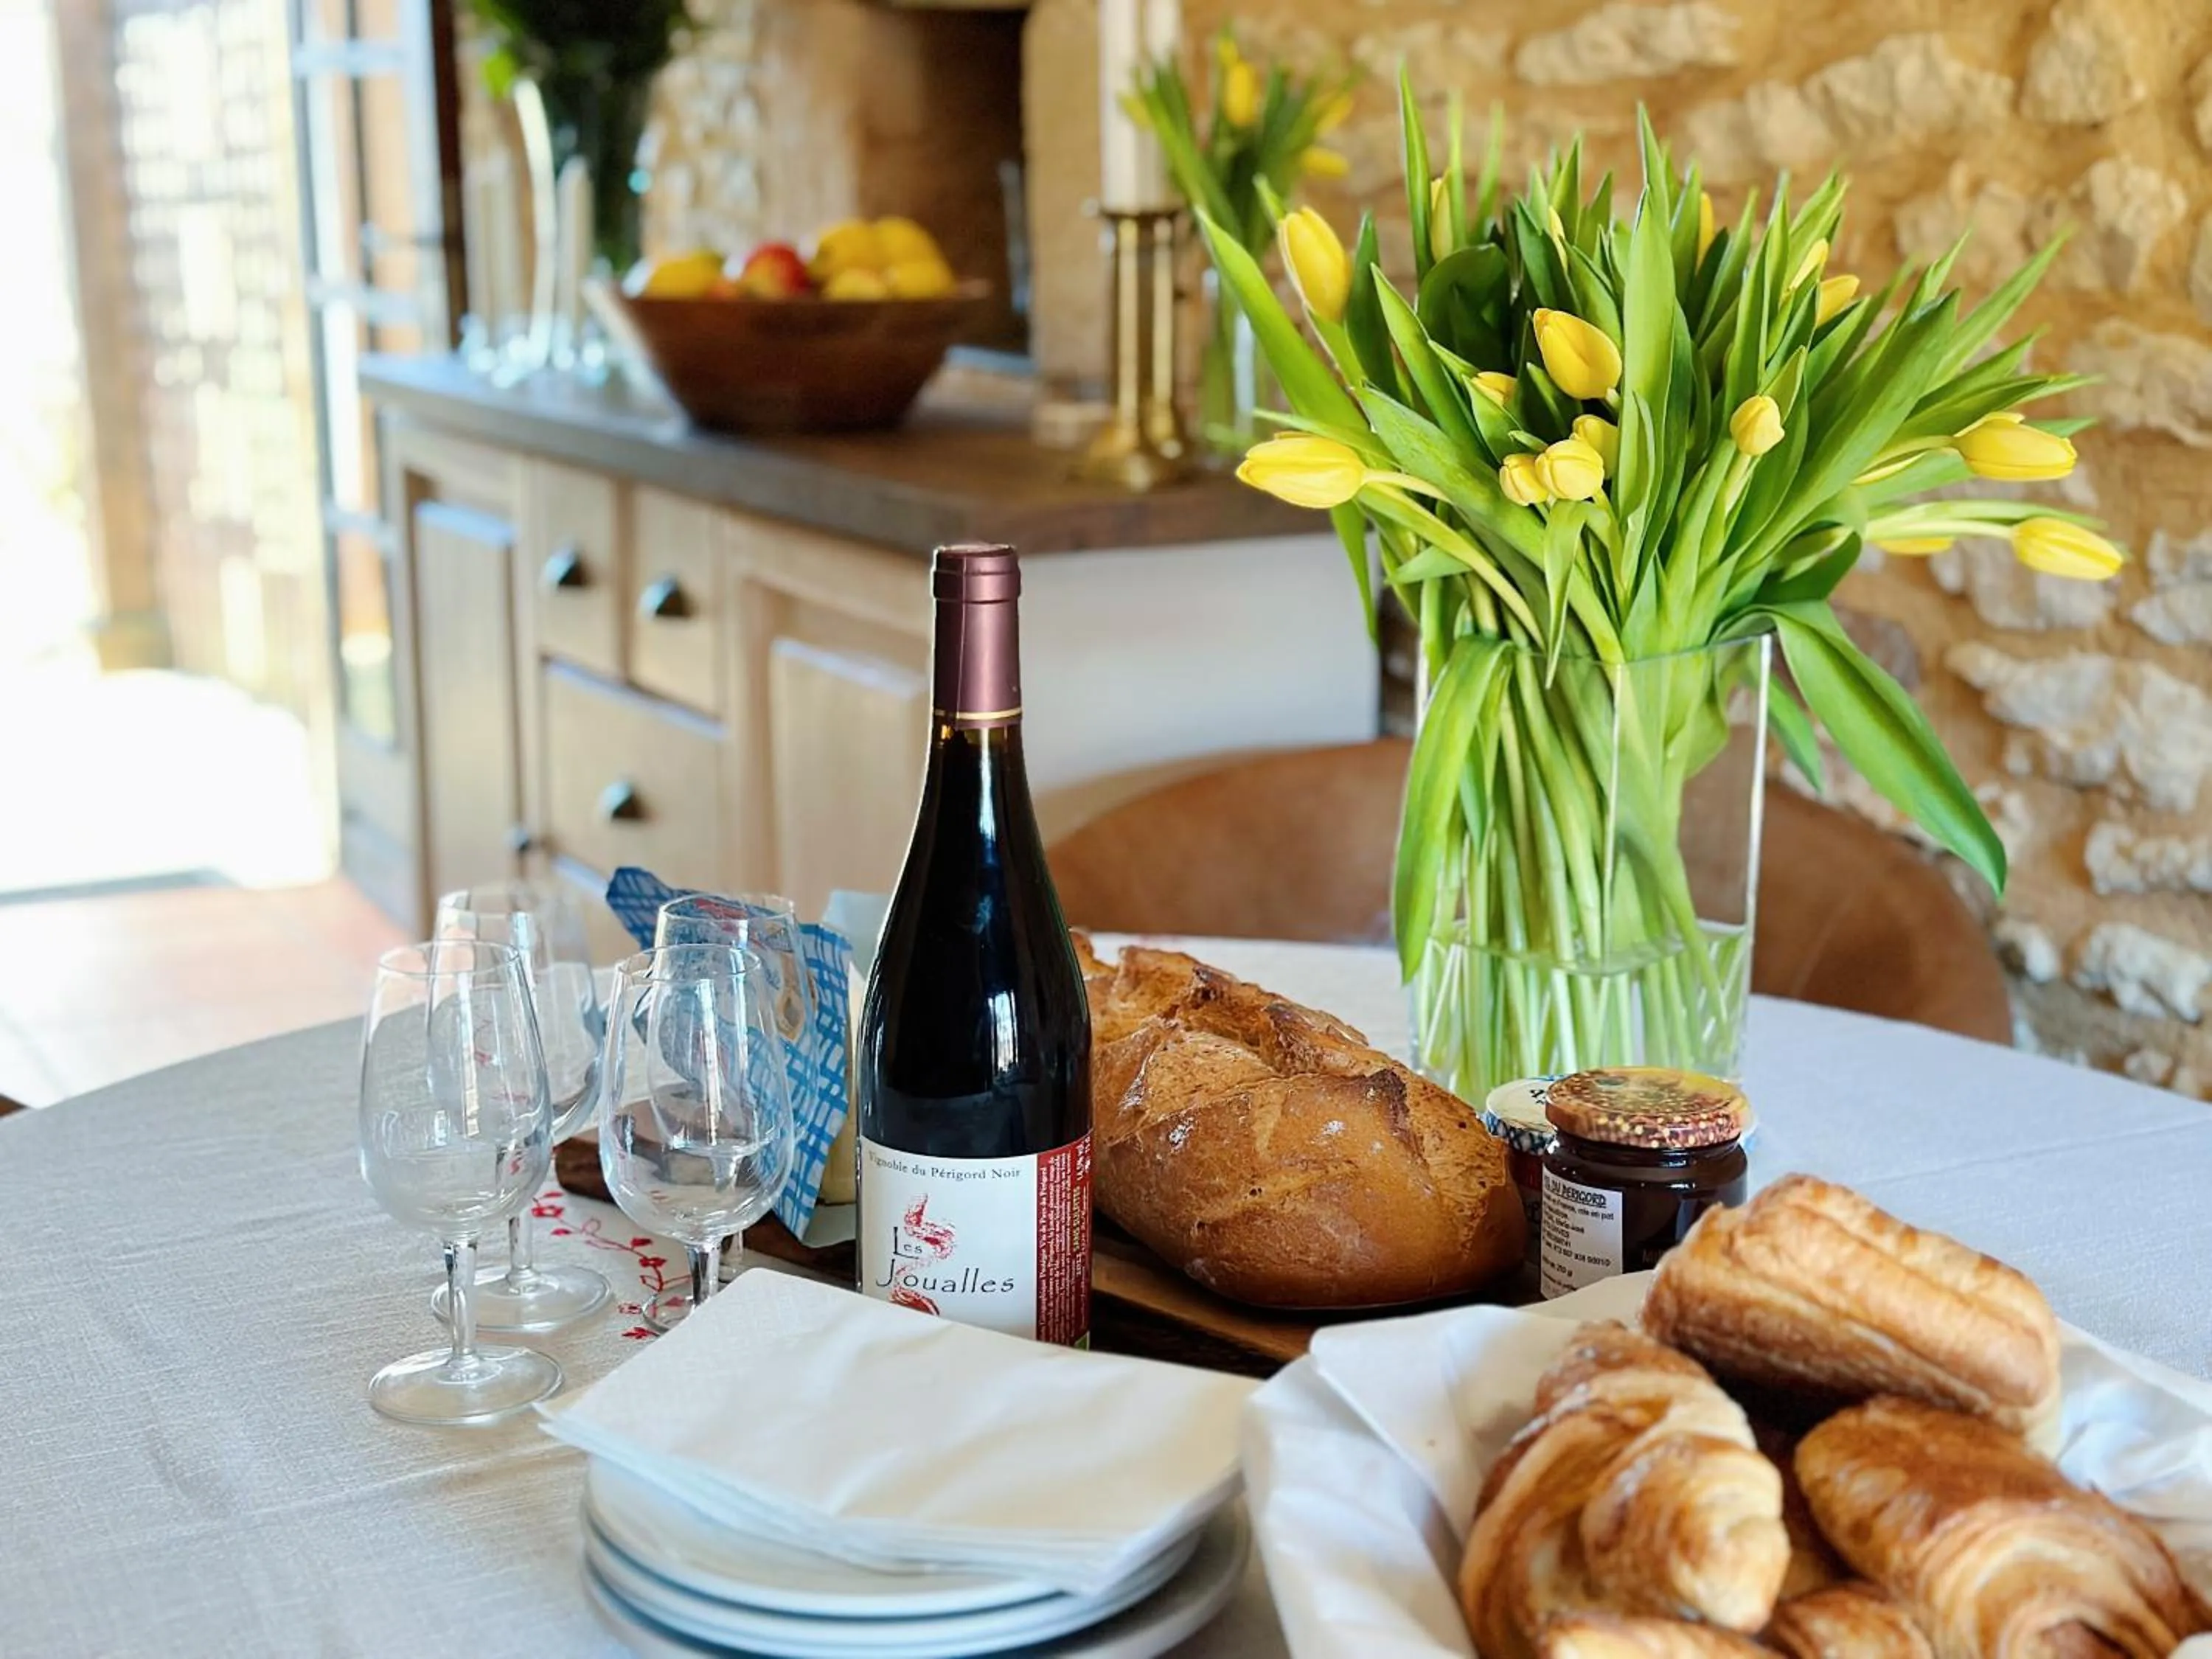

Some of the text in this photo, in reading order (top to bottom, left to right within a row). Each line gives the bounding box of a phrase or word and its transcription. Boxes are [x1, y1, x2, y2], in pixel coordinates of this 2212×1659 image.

[868, 1150, 1021, 1181] Vignoble du Périgord Noir
[893, 1226, 922, 1259] Les
[875, 1258, 1015, 1293] Joualles
